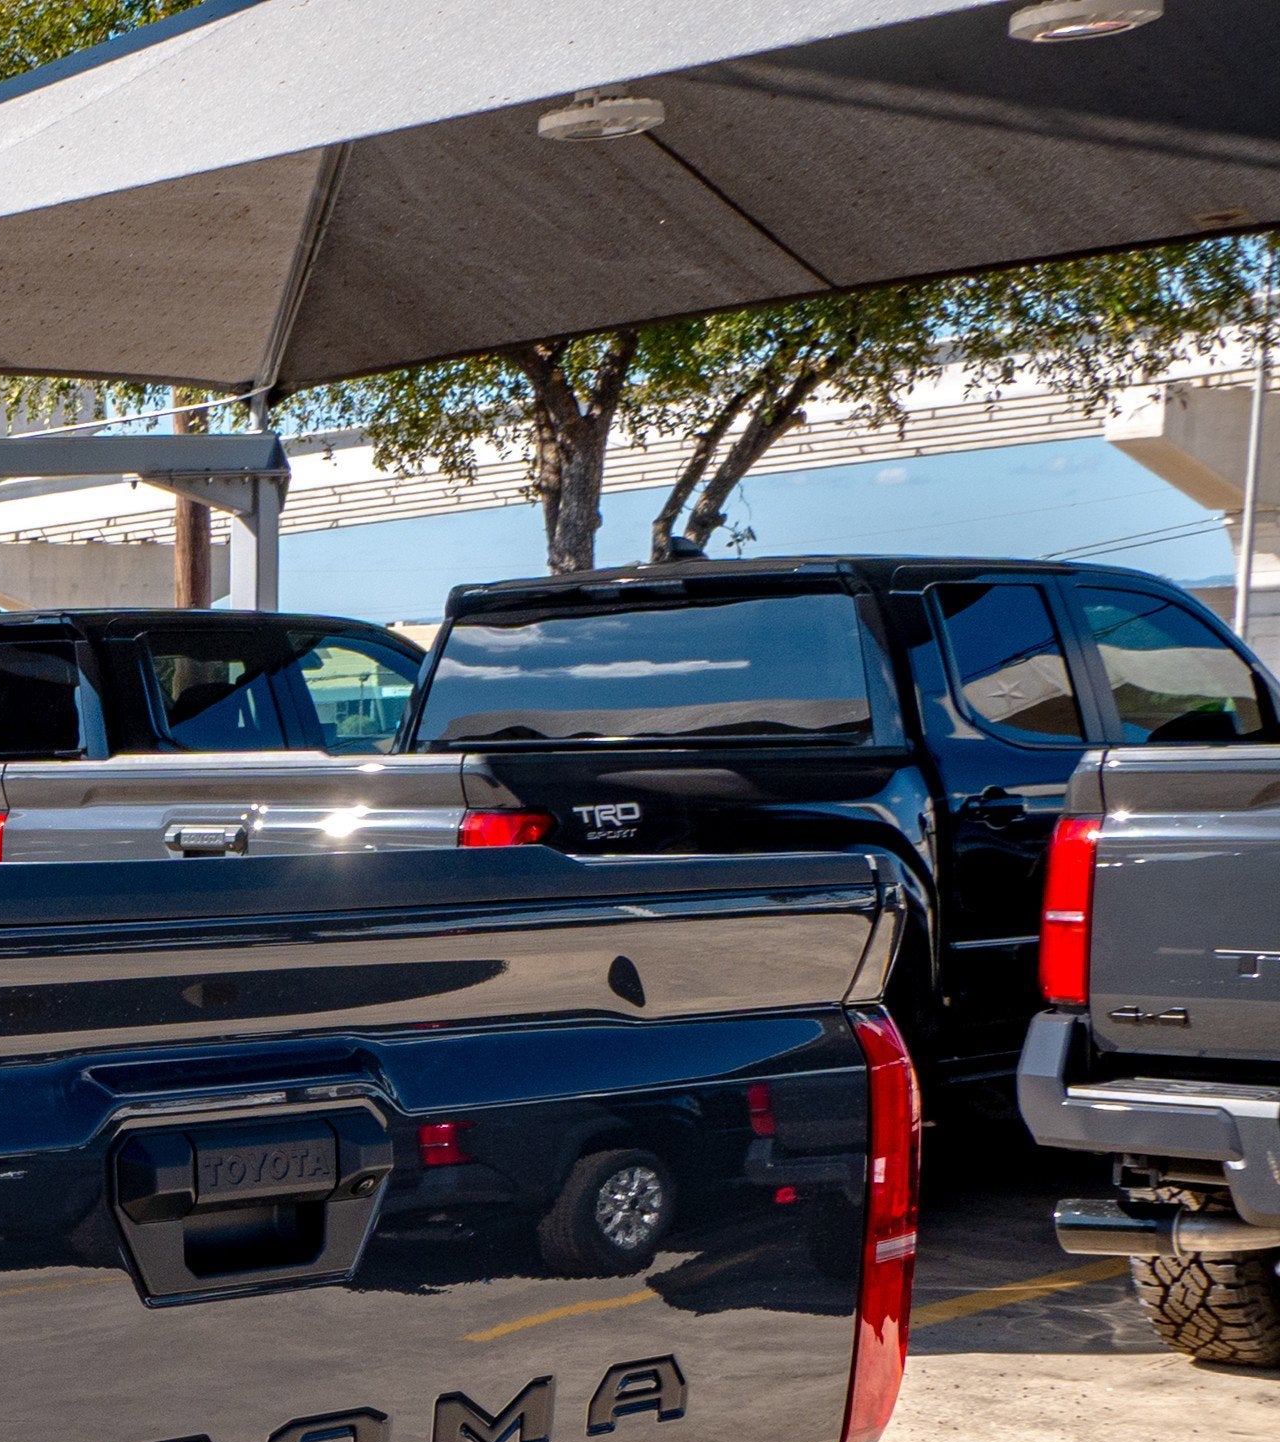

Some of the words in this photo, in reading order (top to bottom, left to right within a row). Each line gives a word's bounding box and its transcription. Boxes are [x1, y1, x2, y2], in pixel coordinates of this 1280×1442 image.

[572, 803, 641, 828] TRD
[587, 828, 638, 840] SPORT
[203, 1148, 332, 1187] TOYOTA
